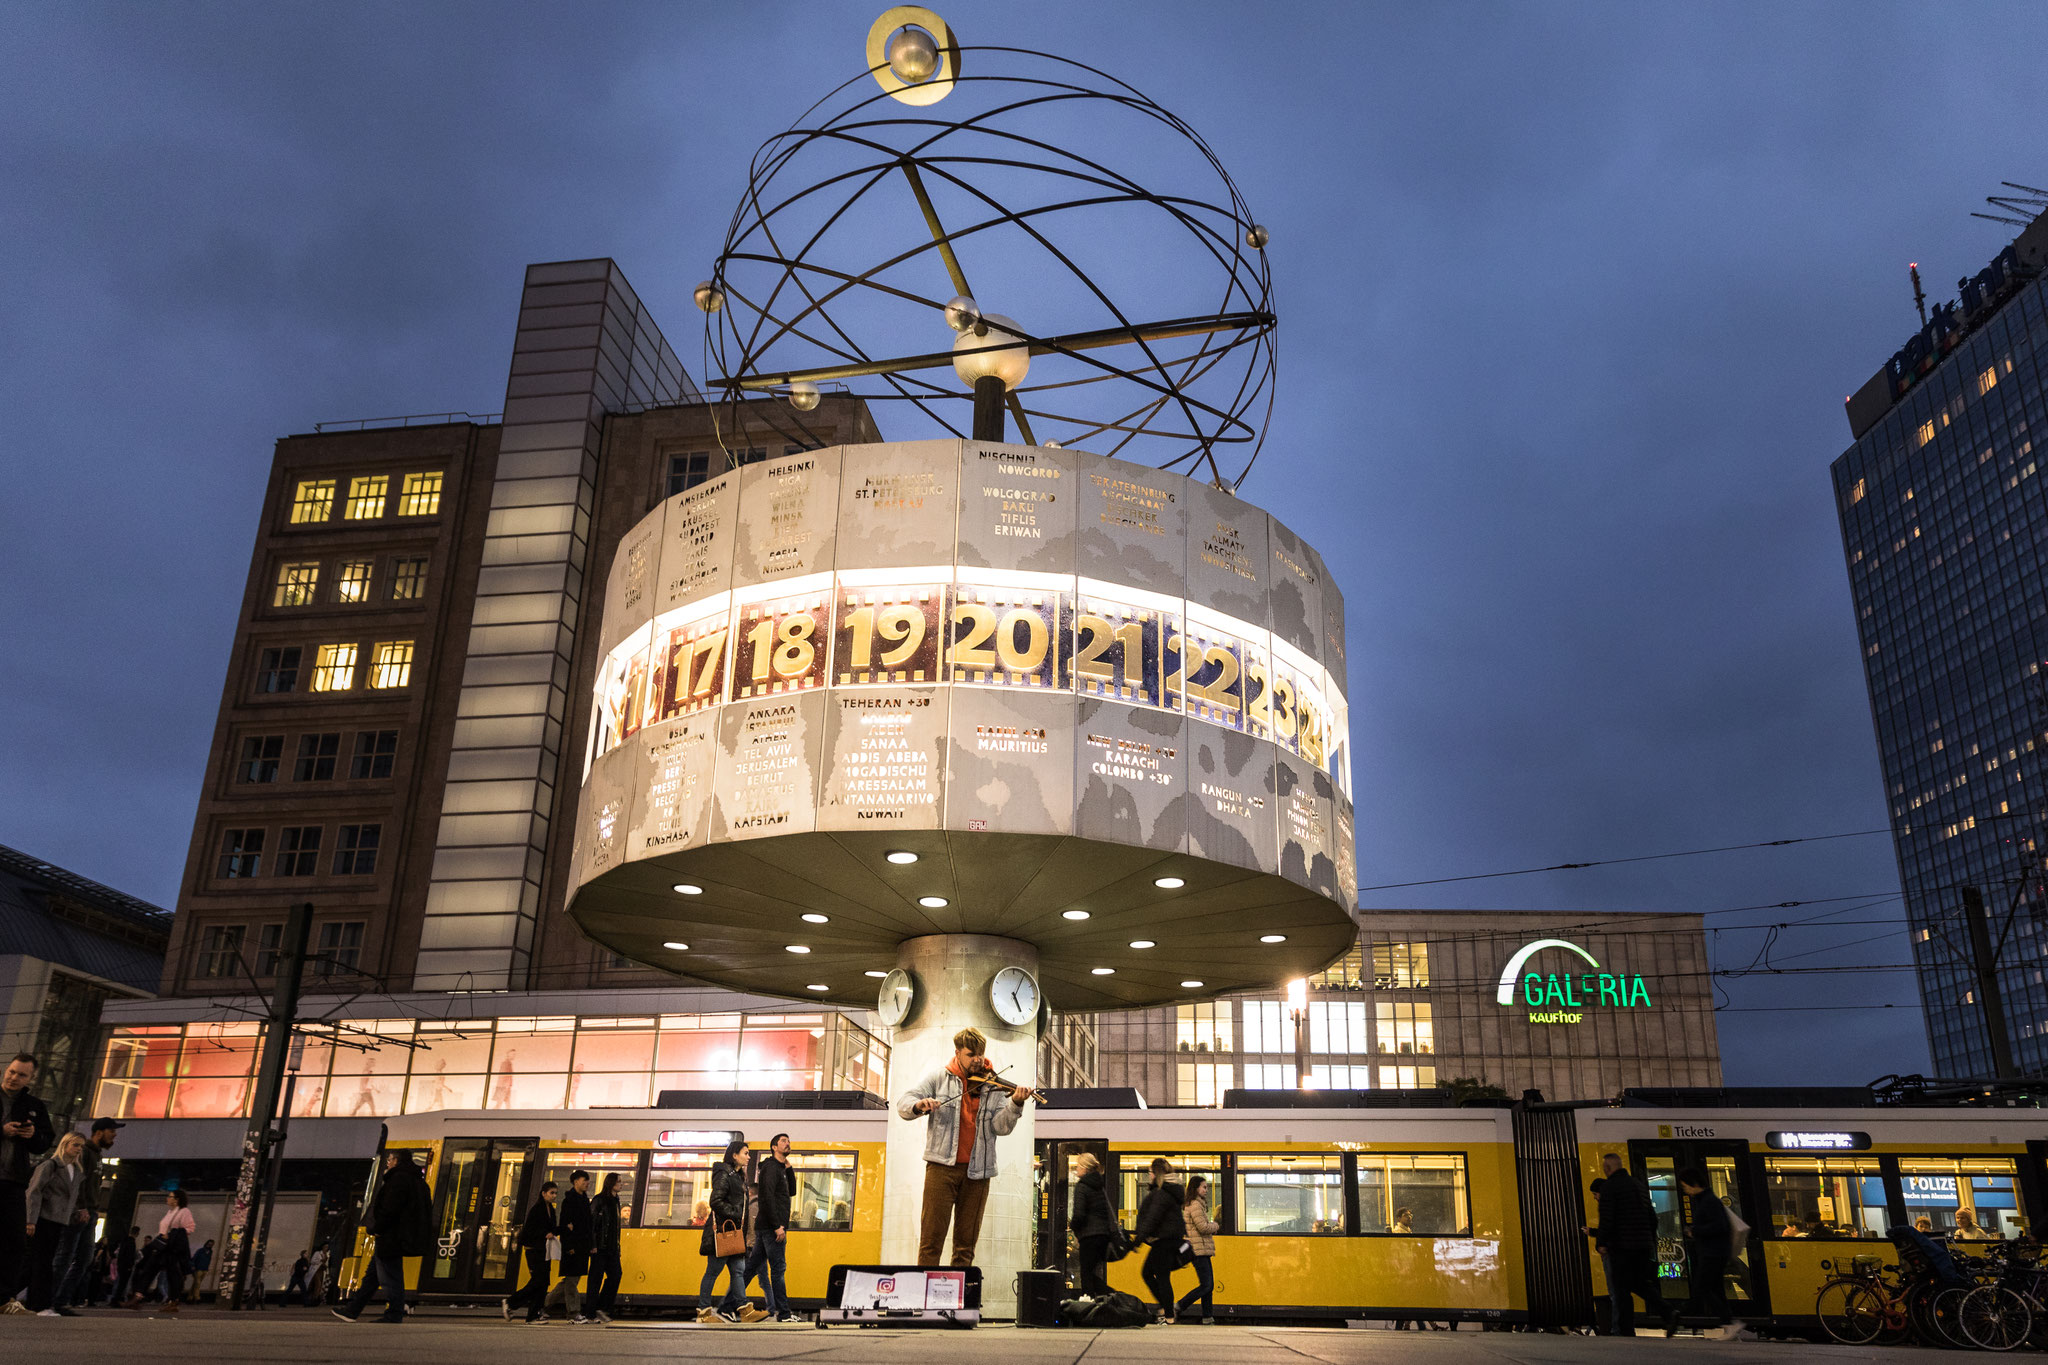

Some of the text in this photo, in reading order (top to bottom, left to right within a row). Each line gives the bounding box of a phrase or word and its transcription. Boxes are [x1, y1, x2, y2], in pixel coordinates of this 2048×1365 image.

[768, 460, 815, 478] HELSINKI
[998, 464, 1061, 479] NOWGOROD
[778, 474, 801, 487] RIGA
[865, 473, 934, 487] MURMNSK
[679, 481, 727, 508] AMSTERDAM
[855, 489, 870, 499] ST.
[982, 486, 1056, 503] WOLGOGRAD
[1002, 500, 1035, 513] BAKU
[770, 511, 803, 525] MINSK
[1000, 513, 1036, 526] TIFLIS
[994, 524, 1041, 539] ERIWAN
[769, 547, 799, 562] SOFIA
[844, 604, 926, 668] 19
[945, 604, 1050, 672] 20
[748, 613, 816, 681] 18
[1067, 615, 1145, 685] 21
[672, 629, 728, 702] 17
[1165, 634, 1240, 711] 22
[842, 698, 902, 709] TEHERAN
[1248, 664, 1297, 738] 23
[747, 704, 796, 720] ANKARA
[669, 727, 688, 739] OSLO
[752, 730, 788, 745] ATHEN
[976, 725, 1020, 739] KABUL
[744, 743, 792, 760] TEL AVIV
[861, 738, 909, 750] SANAA
[978, 738, 1048, 753] MAURITIUS
[1086, 733, 1112, 748] NEW
[1117, 739, 1151, 755] DELHI
[841, 751, 928, 764] ADDIS ABEBA
[1105, 750, 1160, 770] KARACHI
[735, 756, 798, 775] JERUSALEM
[1092, 761, 1144, 781] COLOMBO
[747, 771, 784, 786] BEIRUT
[842, 779, 926, 791] ARESSALAM
[830, 792, 935, 806] ANTANANARIVO
[1201, 782, 1242, 803] RANGUN
[857, 807, 906, 819] KUWAIT
[1216, 799, 1252, 819] DHAKA
[734, 810, 790, 829] KAPSTADT
[646, 830, 690, 848] KINSHASA
[1524, 972, 1652, 1007] GALERIA
[1674, 1126, 1715, 1137] Tickets
